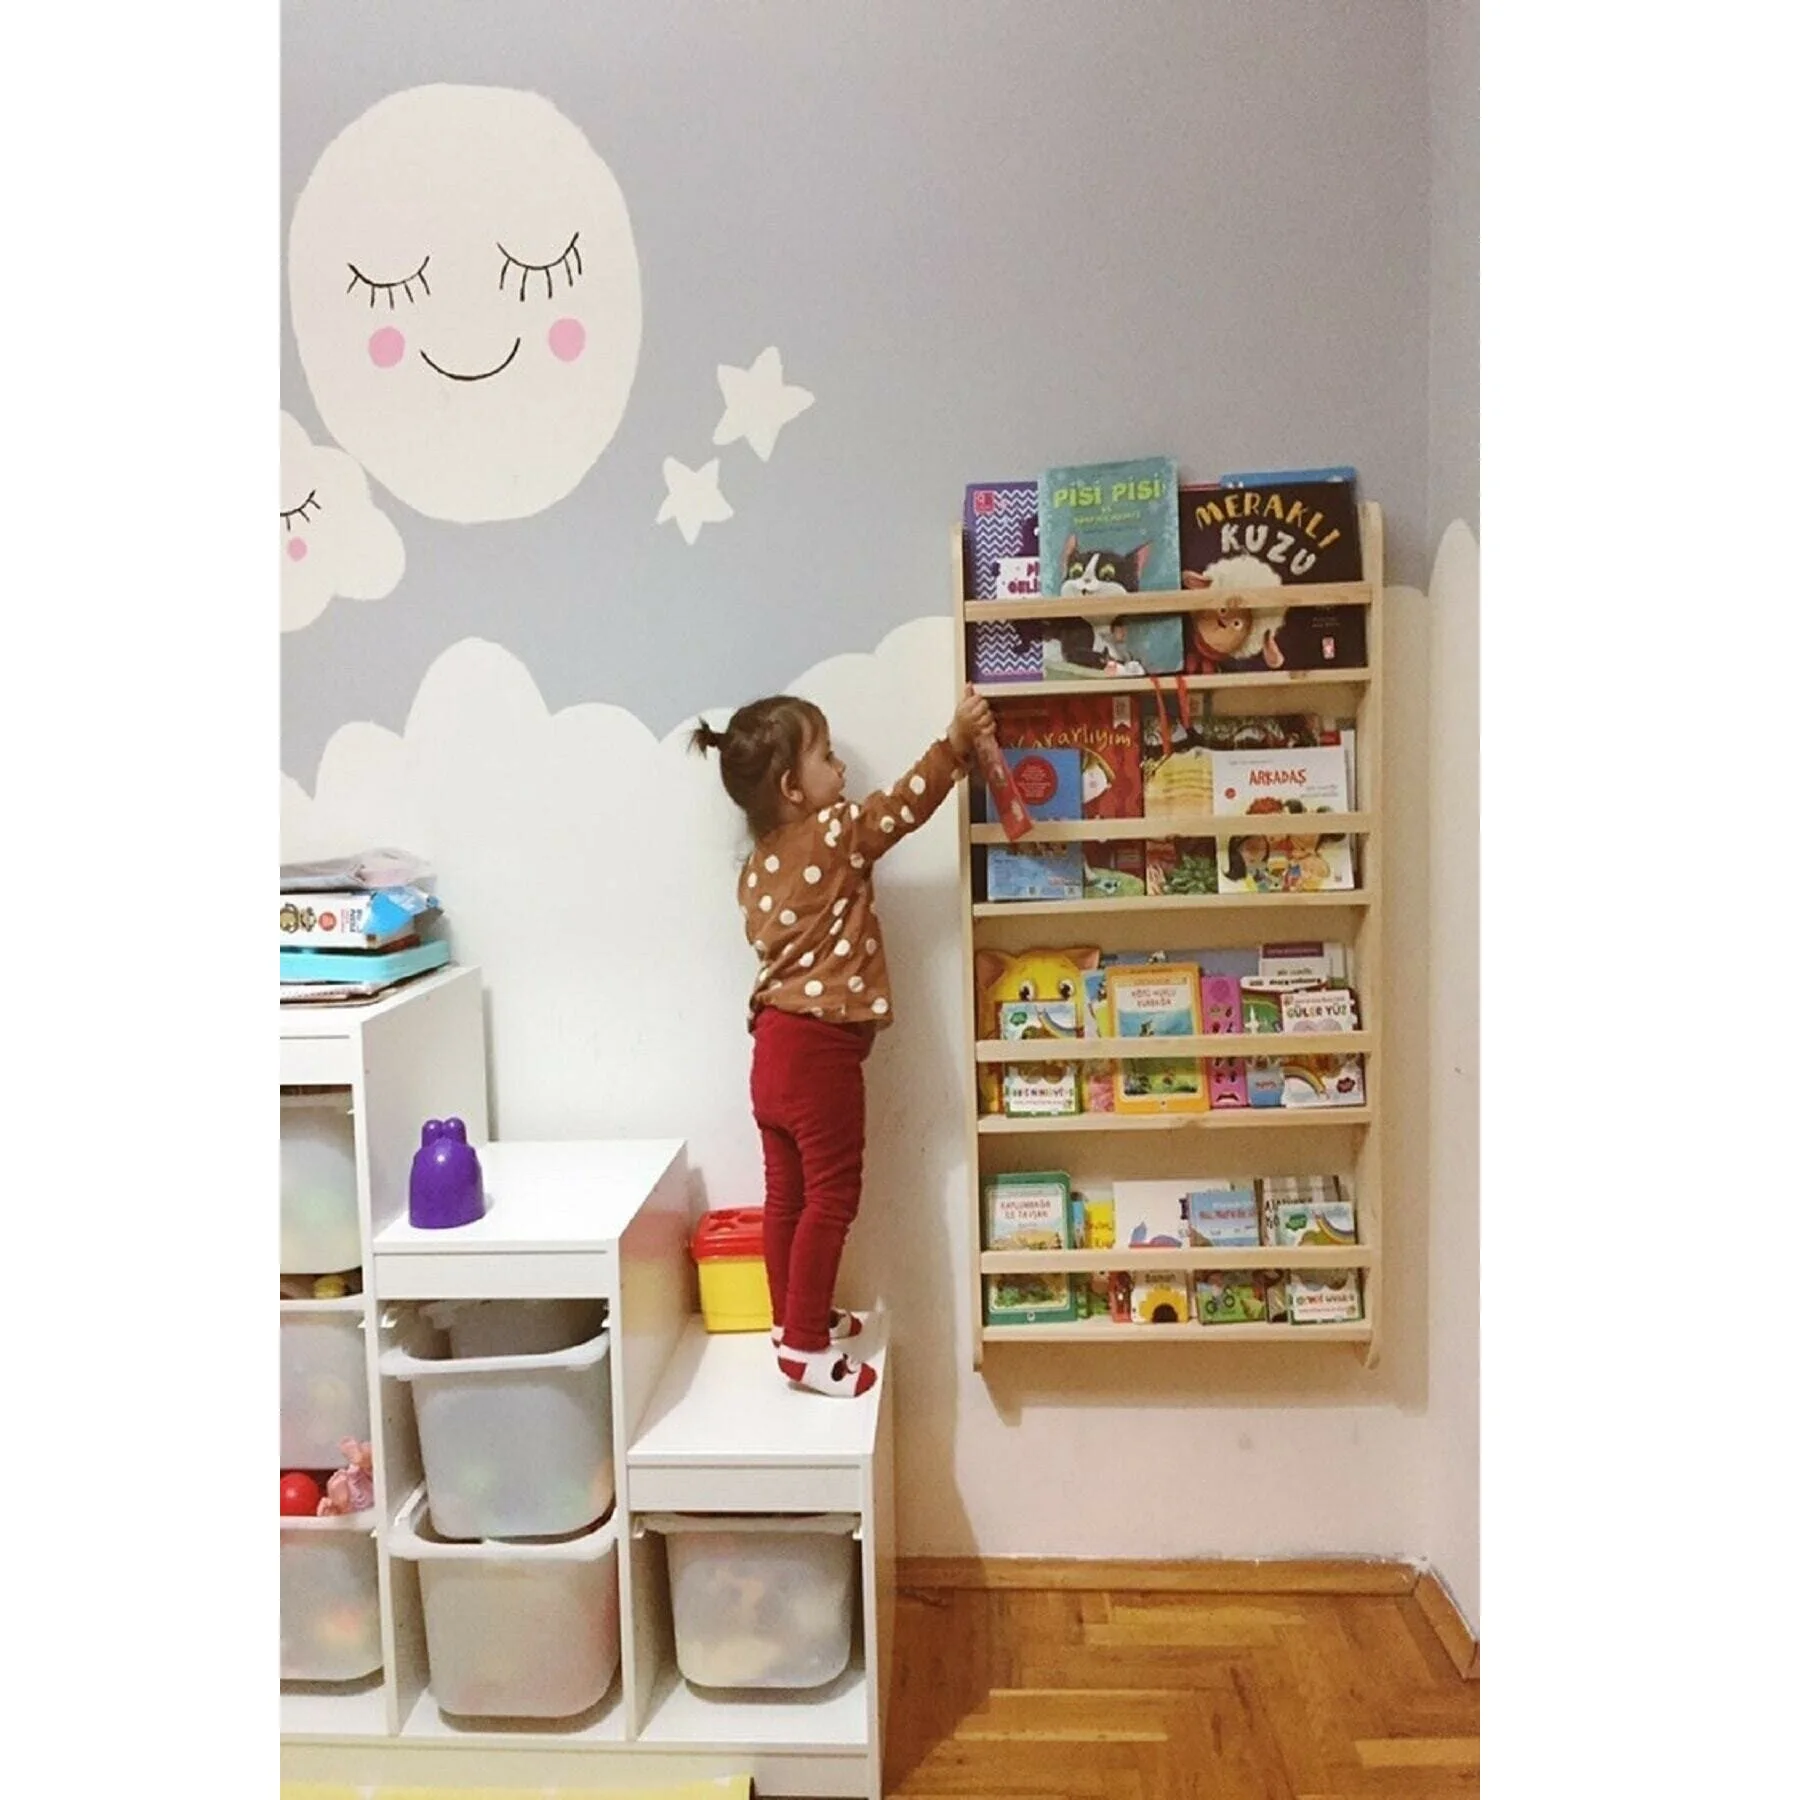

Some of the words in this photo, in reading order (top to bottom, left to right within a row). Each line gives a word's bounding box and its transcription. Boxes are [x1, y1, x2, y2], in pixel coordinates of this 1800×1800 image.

[1195, 492, 1341, 549] MERAKLI
[1221, 523, 1316, 575] KUZU
[1248, 769, 1306, 786] ARKADAŞ
